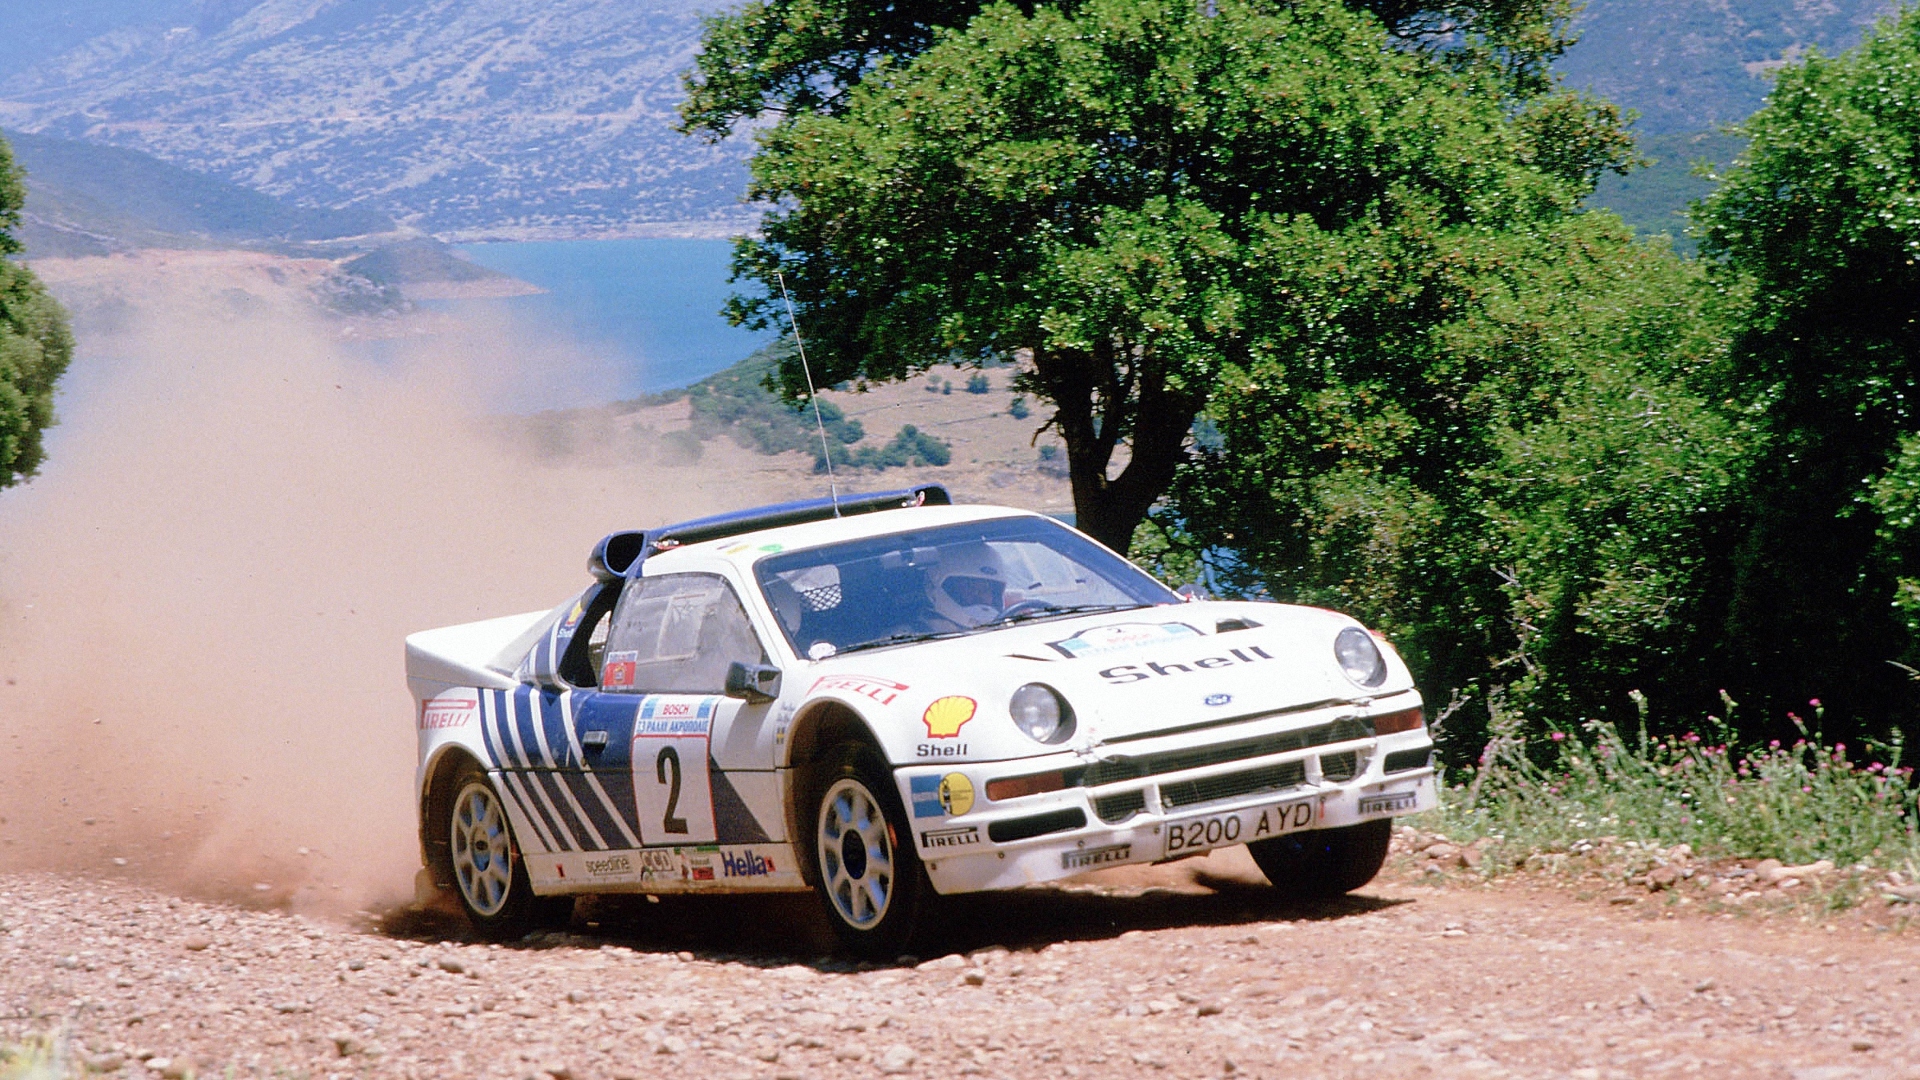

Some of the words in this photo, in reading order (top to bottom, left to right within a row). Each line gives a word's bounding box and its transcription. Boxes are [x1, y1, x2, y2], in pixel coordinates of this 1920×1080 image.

[1099, 646, 1275, 685] Shell
[420, 699, 477, 729] PIRELLI
[663, 704, 690, 716] BOSCH
[916, 743, 968, 757] Shell
[656, 745, 688, 834] 2
[1358, 791, 1417, 815] PIRELLI
[920, 826, 980, 848] PIRELLI
[1168, 814, 1241, 851] B200
[1256, 802, 1312, 837] AYD
[721, 850, 768, 877] Hella
[1061, 843, 1132, 870] PIRELLI
